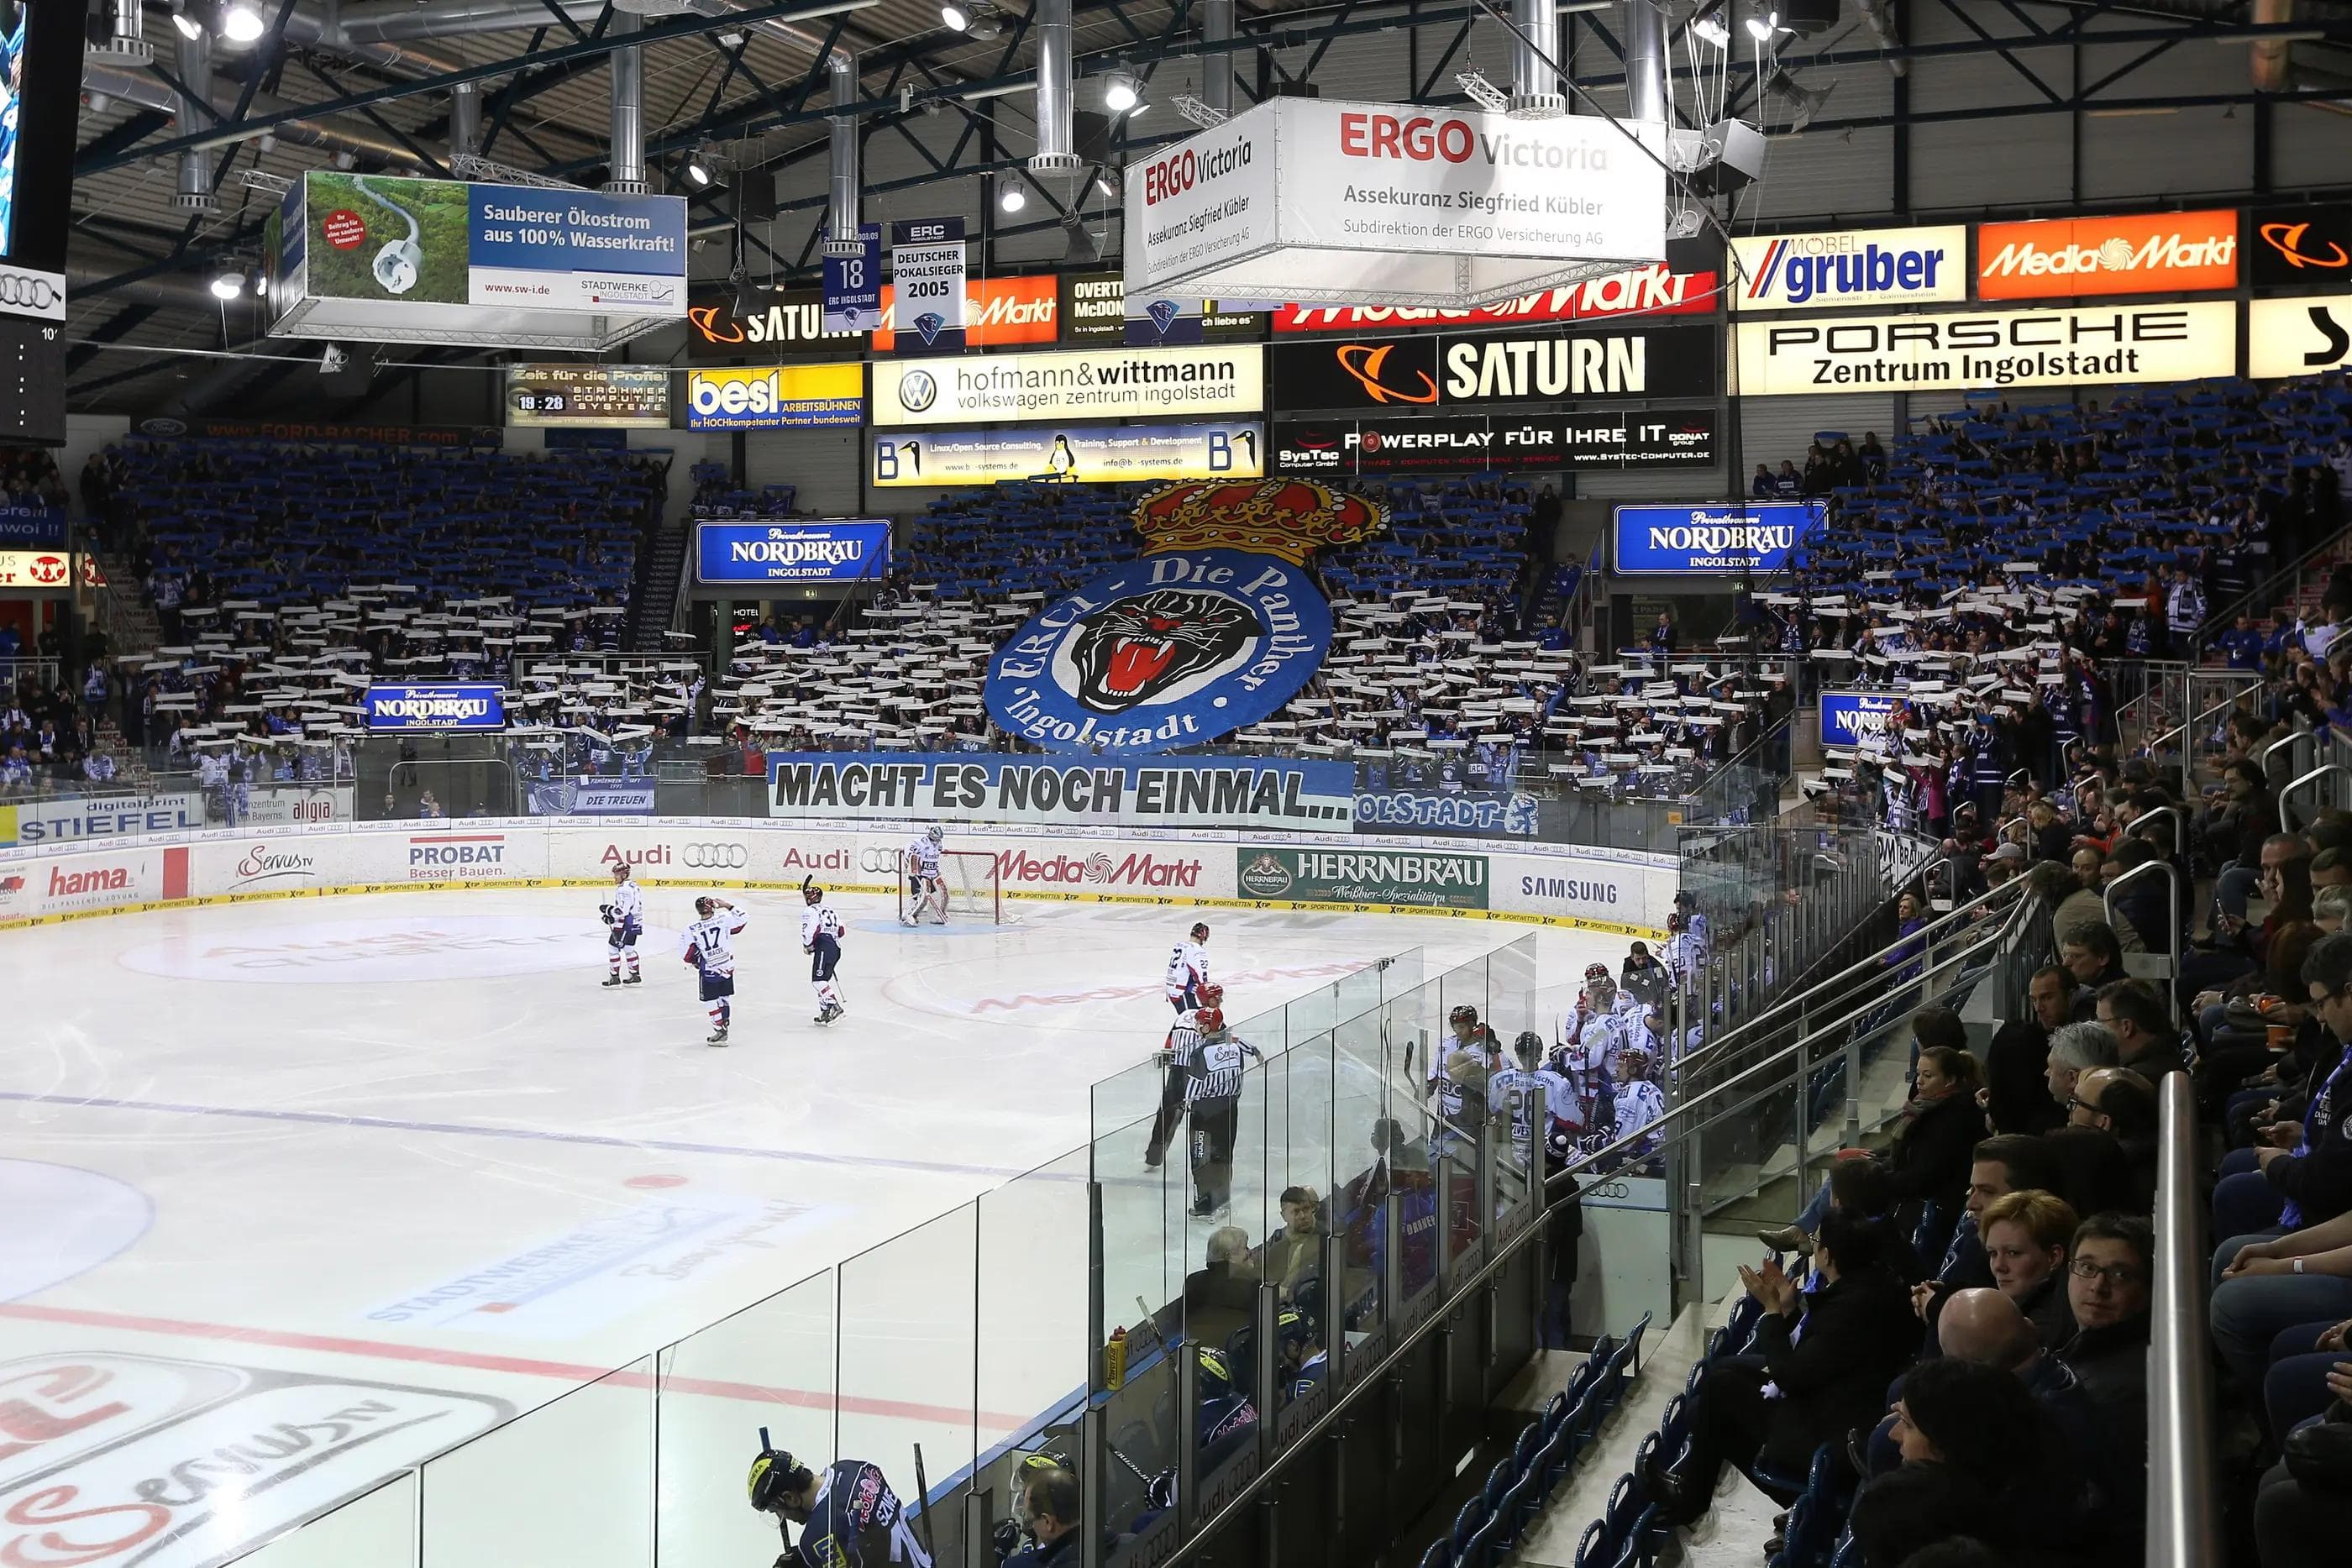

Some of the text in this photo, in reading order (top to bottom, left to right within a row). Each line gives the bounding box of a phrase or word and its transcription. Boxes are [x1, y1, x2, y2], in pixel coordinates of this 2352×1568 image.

[1341, 113, 1608, 170] ERGO Victoria
[1146, 134, 1252, 206] ERGO Victoria
[1344, 185, 1603, 215] Assekuranz Siegfried Kübler
[484, 204, 650, 229] Sauberer Ökostrom
[1148, 195, 1249, 248] Assekuranz Siegfried Kübler
[484, 228, 513, 244] aus
[570, 231, 675, 252] Wasserkraft!
[911, 225, 944, 237] ERC
[1344, 219, 1603, 247] Subdirektion der ERGO Versicherung AG
[1147, 227, 1249, 275] Subdirektion der ERGO Versicherung AG
[1788, 235, 1861, 254] MÖBEL
[1981, 233, 2235, 277] Media Markt
[898, 250, 959, 264] DEUTSCHER
[840, 259, 864, 289] 18
[894, 265, 963, 278] POKALSIEGER
[1787, 244, 1944, 303] gruber
[485, 283, 550, 295] www.sw-i.de
[581, 281, 648, 291] STADTWERKE
[599, 291, 648, 301] INGOLSTADT
[908, 281, 949, 297] 2005
[1074, 281, 1124, 298] OVERTI
[828, 294, 875, 306] ERC INGOLSTADT
[978, 296, 1057, 325] Markt
[1074, 301, 1124, 318] McDON
[1215, 317, 1237, 327] liebe
[1769, 312, 2187, 356] PORSCHE
[512, 370, 548, 380] Zeit
[552, 370, 578, 380] für
[583, 370, 607, 380] die
[1447, 336, 1646, 398] SATURN
[1814, 349, 2139, 385] Zentrum Ingolstadt
[573, 385, 667, 394] STRÖHMER
[691, 369, 780, 415] besl
[958, 384, 1236, 409] volkswagen zentrum ingolstadt
[782, 399, 861, 413] ARBEITSBÜHNEN
[690, 415, 861, 428] Ihr HOCHkompetenter Partner bundesweit
[1108, 438, 1139, 448] Support
[1151, 437, 1202, 448] Development
[1640, 425, 1667, 443] IT
[1668, 433, 1710, 442] DONAT
[930, 442, 1043, 454] Linux/Open Source Consulting,
[1649, 525, 1795, 553] NORDBRÄU
[731, 540, 863, 565] NORDBRÄU
[1689, 556, 1761, 568] INGOLSTADT
[768, 567, 832, 577] INGOLSTADT
[1147, 556, 1318, 694] Die Panther
[374, 699, 489, 719] NORDBRÄU
[1004, 687, 1200, 749] Ingolstadt
[586, 795, 647, 805] DIE TREUEN
[774, 763, 1349, 822] MACHT ES NOCH EINMAL...
[87, 797, 186, 812] digitalprint
[1354, 793, 1499, 829] OLSTADT
[21, 810, 202, 841] STIEFEL
[410, 846, 505, 865] PROBAT
[600, 844, 672, 864] Audi
[783, 847, 849, 870] Audi
[410, 867, 506, 879] Besser Bauen.
[984, 849, 1203, 887] Media Markt
[1297, 852, 1483, 887] HERRNBRÄU
[49, 866, 129, 897] hama
[1521, 875, 1617, 904] SAMSUNG
[60, 897, 101, 907] PASSENDE
[106, 892, 139, 902] LÖSUNG
[1331, 884, 1446, 906] Weißbier-Spezialitäten
[701, 926, 721, 951] 17
[1590, 922, 1623, 932] SPORTWETTEN
[1497, 1219, 1515, 1247] Audi
[367, 1231, 603, 1324] STADTWERKE
